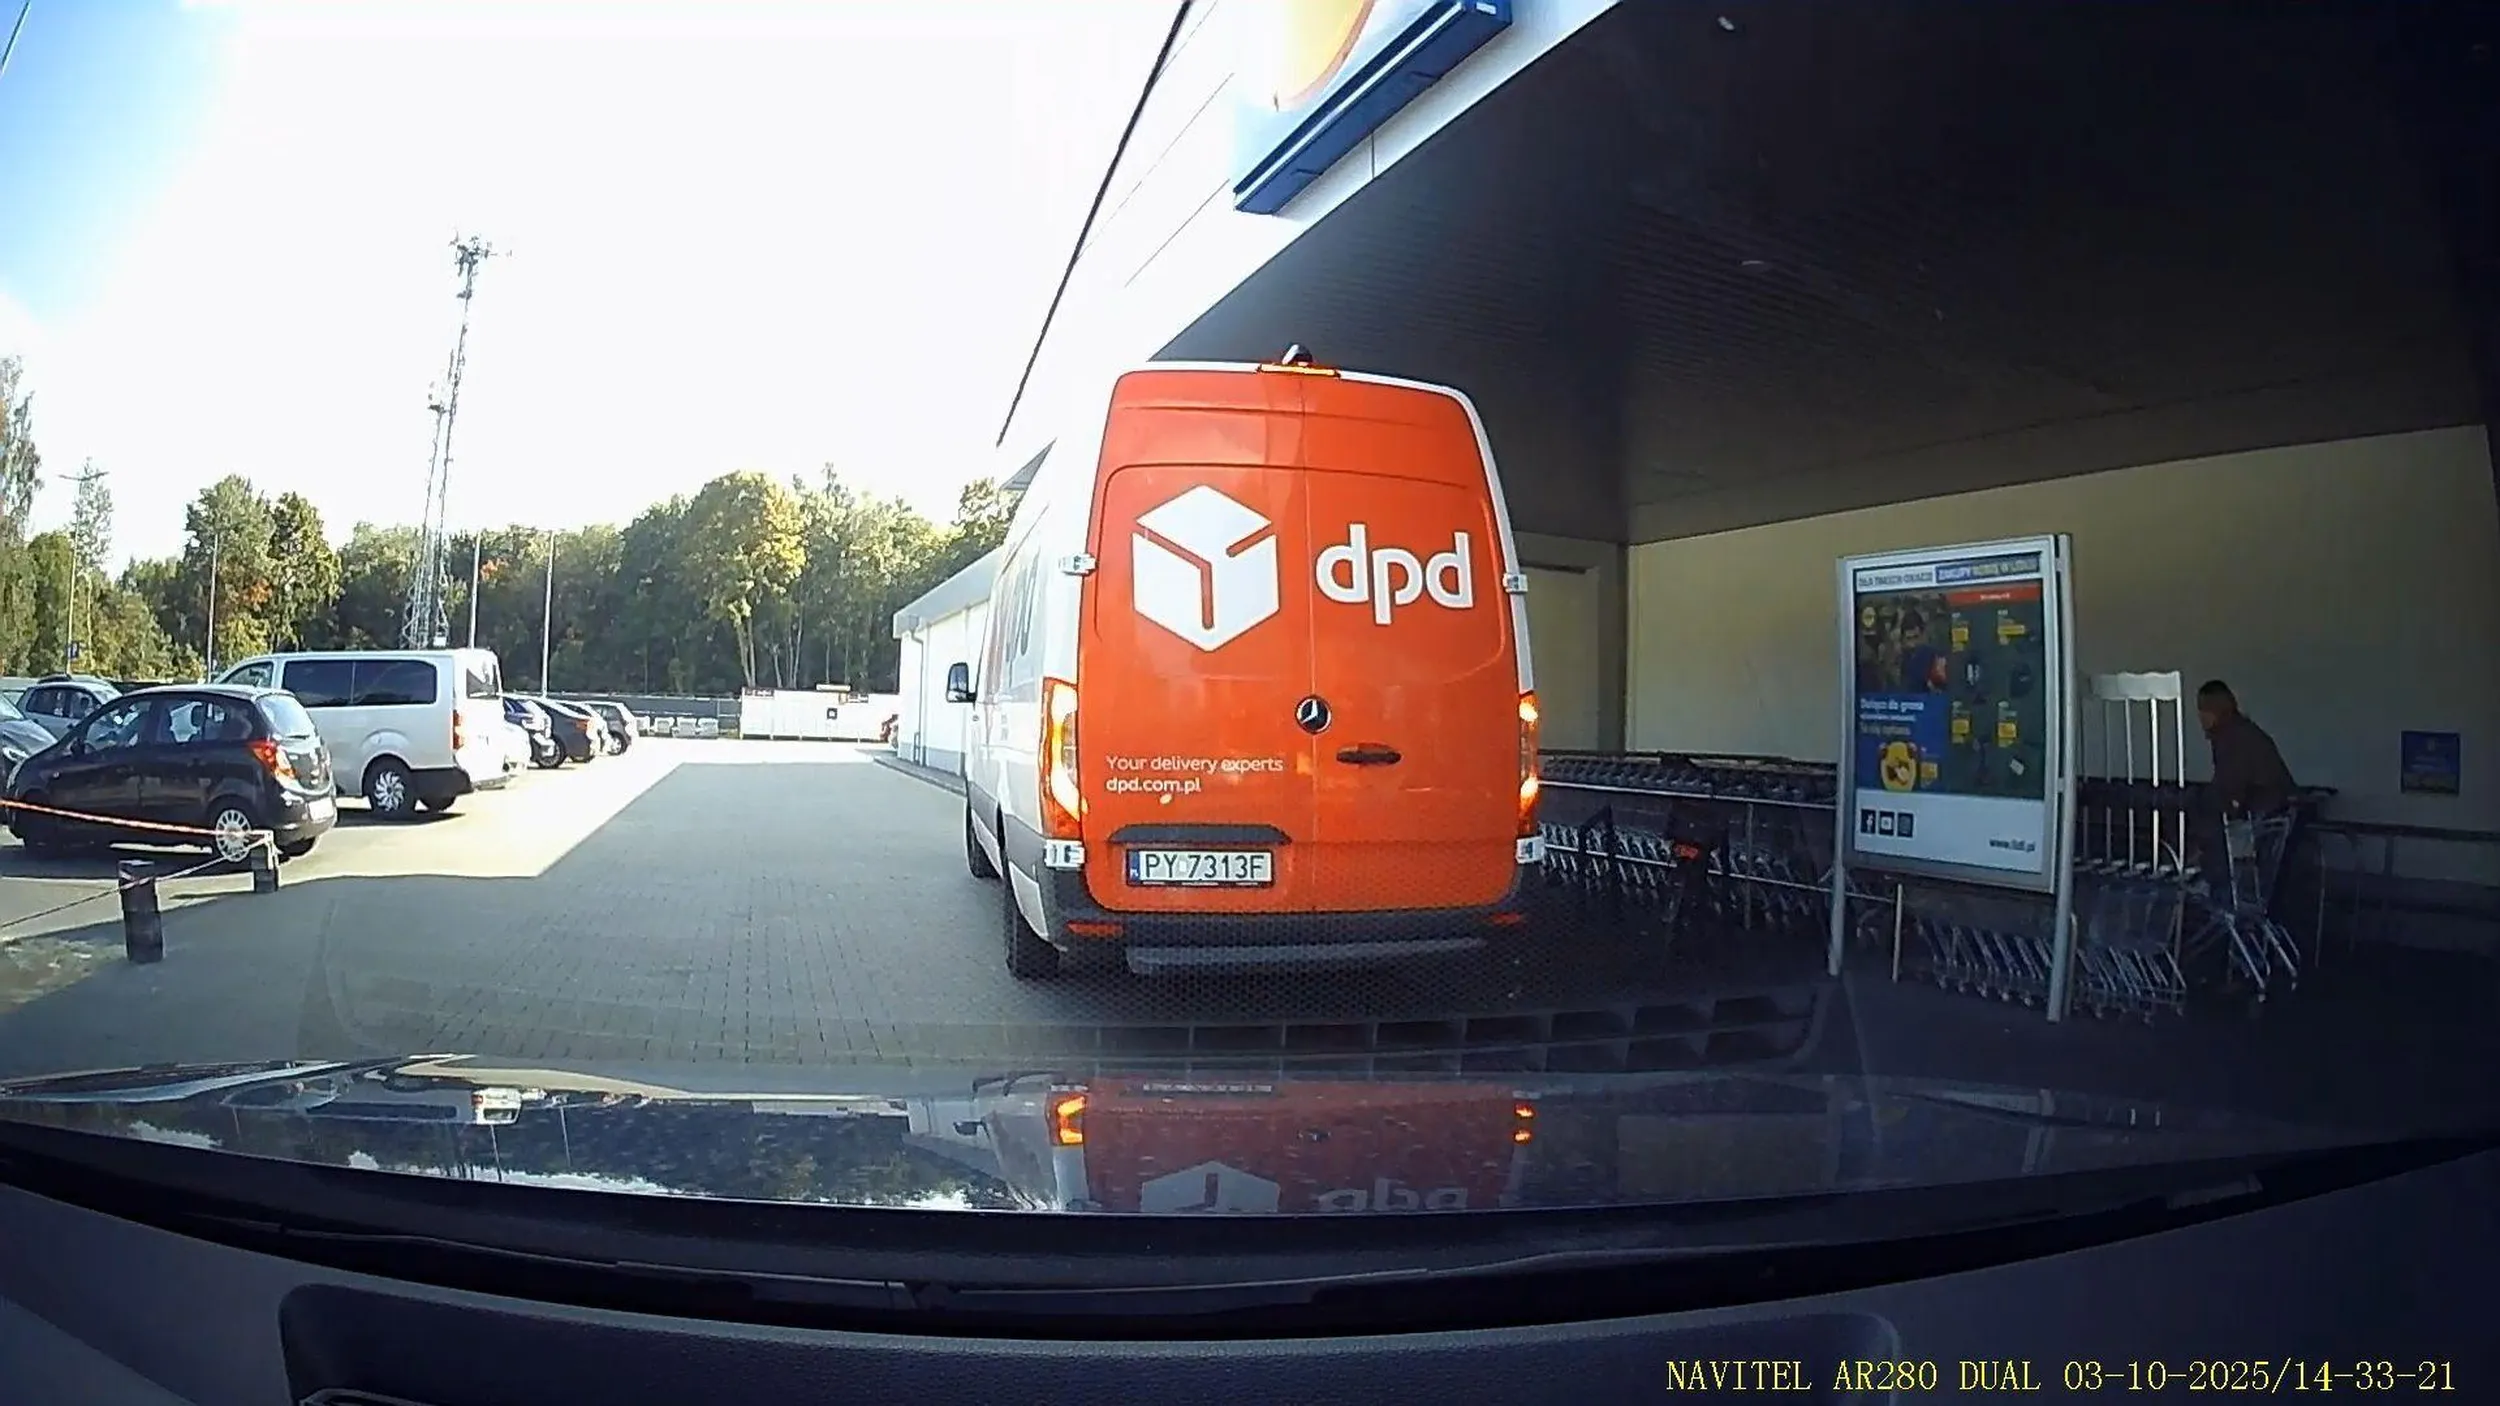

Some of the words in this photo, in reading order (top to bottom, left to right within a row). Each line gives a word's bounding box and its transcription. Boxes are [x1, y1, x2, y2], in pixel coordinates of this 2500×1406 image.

[1315, 523, 1474, 625] dpd
[1105, 754, 1147, 772] Your
[1150, 756, 1217, 775] delivery
[1220, 757, 1284, 775] experts
[1105, 777, 1202, 795] dpd.com.pl
[1144, 853, 1178, 878] PY
[1187, 854, 1265, 879] 7313F
